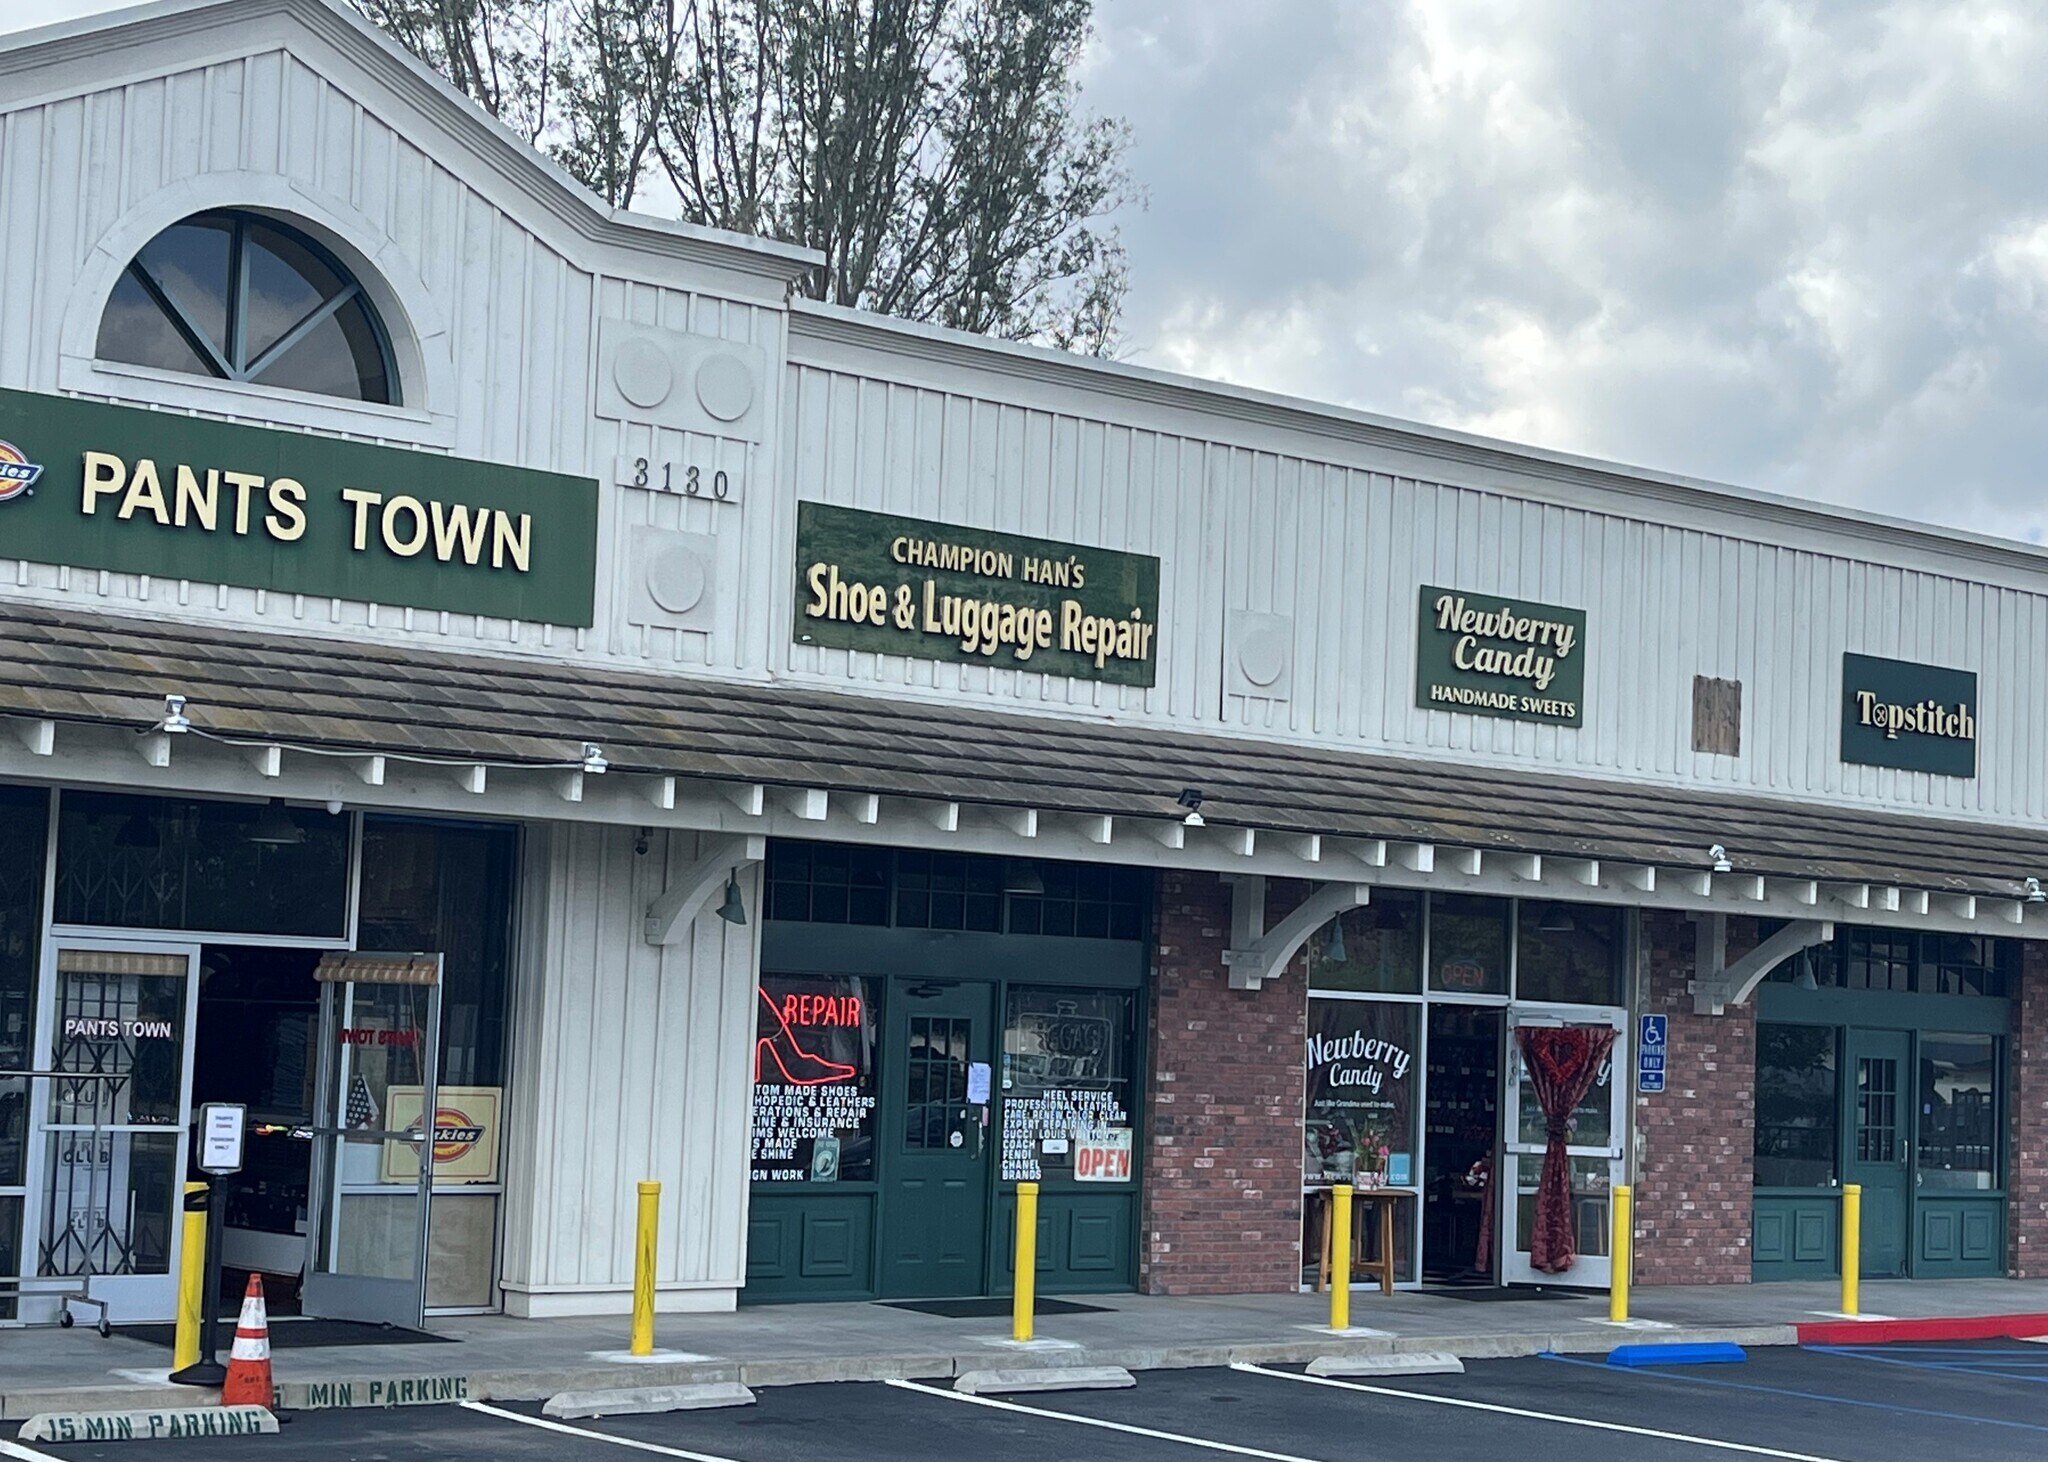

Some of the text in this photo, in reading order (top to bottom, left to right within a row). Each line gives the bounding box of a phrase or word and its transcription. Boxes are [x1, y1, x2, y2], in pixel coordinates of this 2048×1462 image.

[0, 463, 31, 479] ies
[634, 457, 728, 499] 3130
[82, 452, 532, 572] PANTS TOWN
[891, 537, 1085, 589] CHAMPION HAN'S
[806, 562, 1153, 669] Shoe & Luggage Repair
[1434, 595, 1576, 658] Newberry
[1452, 635, 1555, 690] Candy
[1431, 685, 1576, 718] HANDMADE SWEETS
[1857, 690, 1974, 740] Topstitch
[783, 993, 860, 1028] REPAIR
[65, 1019, 171, 1038] PANTS TOWN
[1307, 1029, 1410, 1079] Newberry
[1330, 1063, 1382, 1094] Candy
[784, 1085, 817, 1096] MADE
[821, 1086, 858, 1097] SHOES
[1043, 1090, 1113, 1101] HEEL SERVICE
[808, 1097, 817, 1107] &
[820, 1097, 876, 1108] LEATHERS
[1004, 1099, 1119, 1111] PROFESSIONAL LEATHER
[814, 1107, 822, 1117] &
[826, 1107, 867, 1118] REPAIR
[1032, 1110, 1064, 1120] RENEW
[1066, 1111, 1094, 1120] COLOR
[1099, 1111, 1127, 1121] CLEAN
[781, 1117, 790, 1127] &
[794, 1117, 860, 1129] INSURANCE
[1003, 1119, 1039, 1129] EXPERT
[1043, 1120, 1094, 1130] REPAIRING
[778, 1127, 834, 1138] WELCOME
[1003, 1129, 1032, 1139] GUCCI
[1039, 1130, 1067, 1139] LOUIS
[764, 1138, 797, 1149] MADE
[1002, 1140, 1035, 1150] COACH
[761, 1149, 794, 1160] SHINE
[1002, 1150, 1032, 1160] FENDI
[1002, 1160, 1040, 1170] CHANEL
[1078, 1148, 1130, 1177] OPEN
[771, 1169, 805, 1180] WORK
[1001, 1170, 1042, 1180] BRANDS
[310, 1382, 354, 1407] MIN
[369, 1377, 469, 1405] PARKING
[47, 1410, 262, 1442] 15 MIN PARKING
